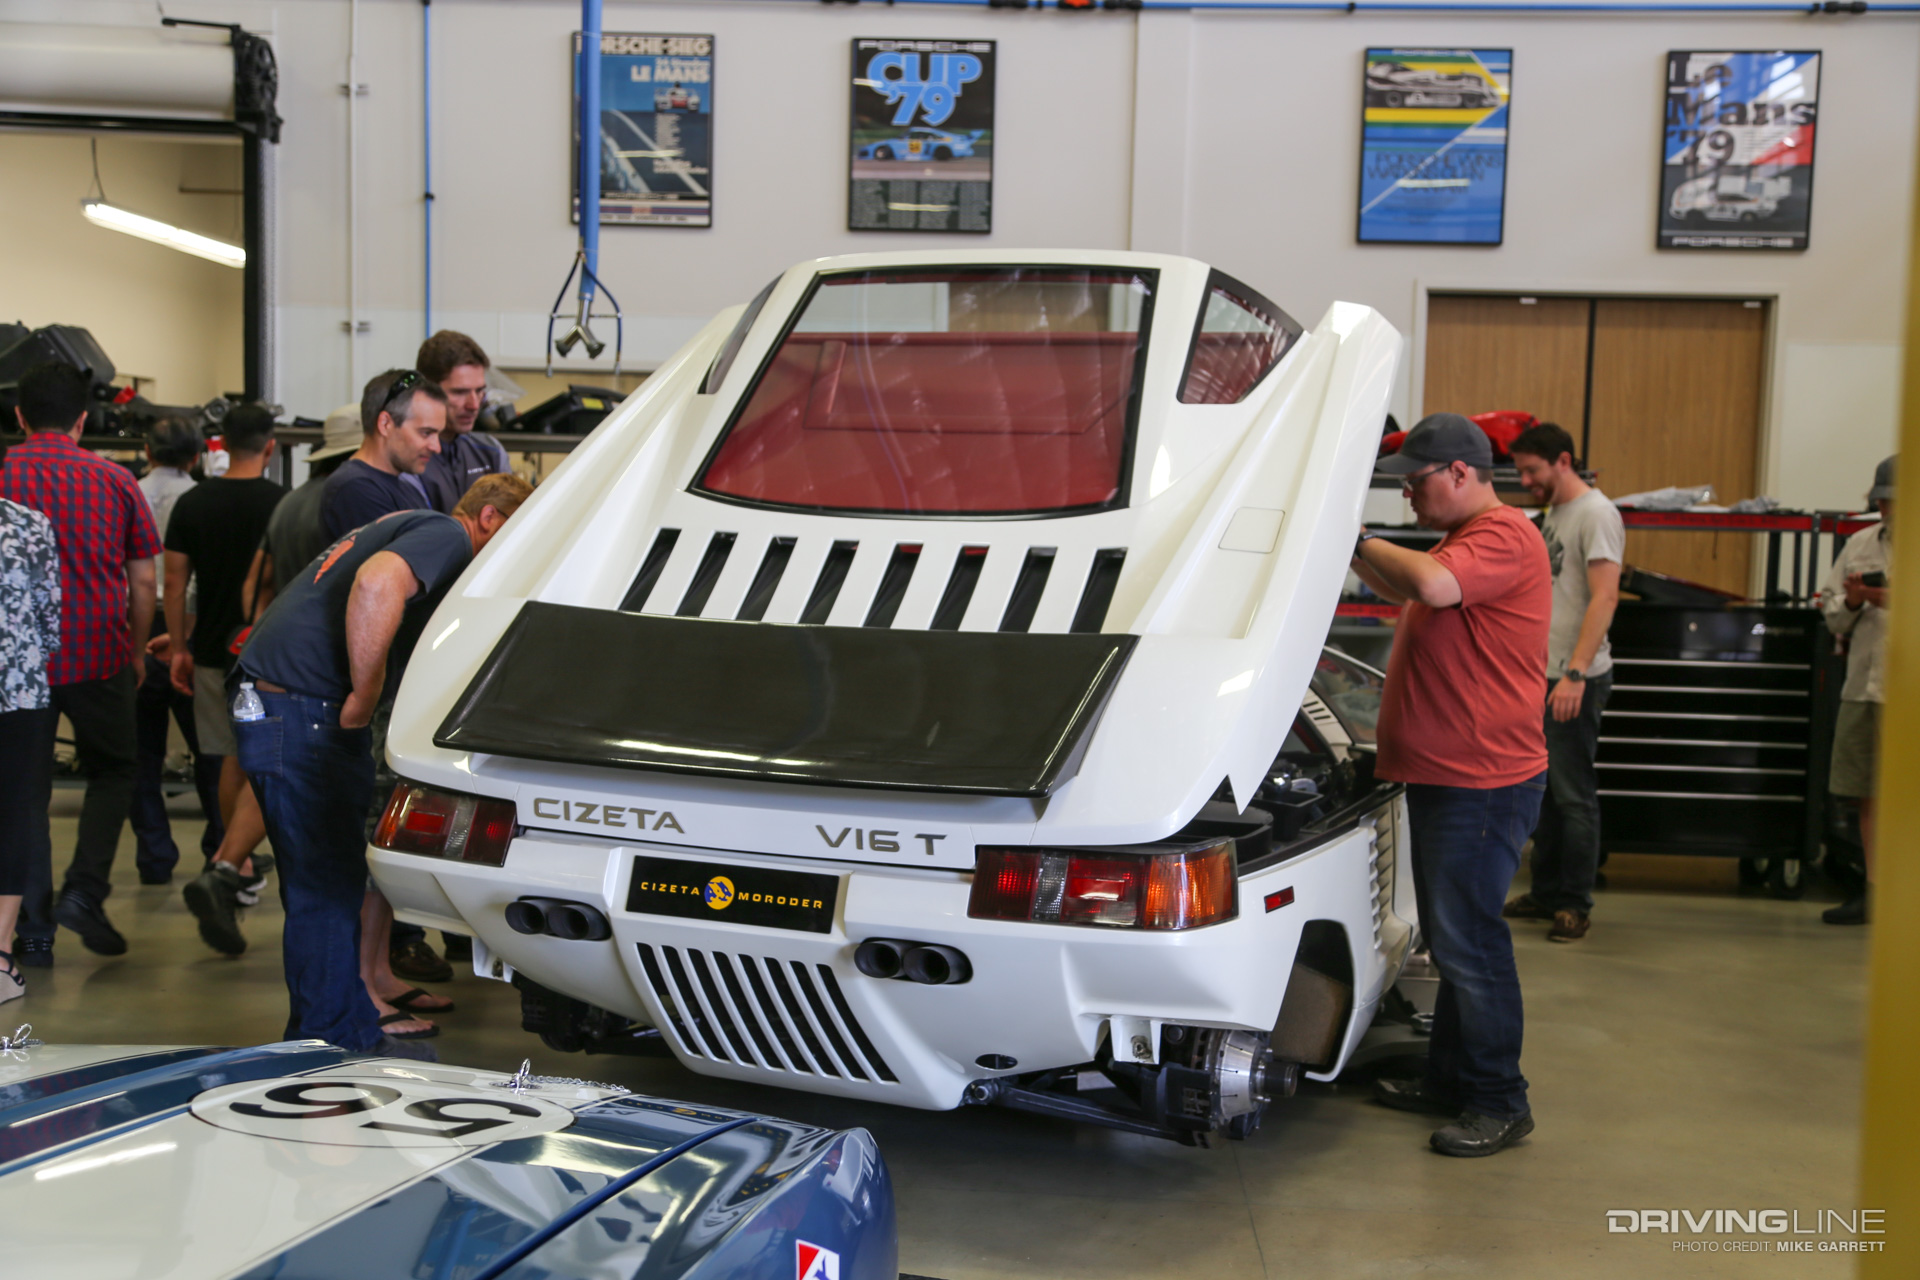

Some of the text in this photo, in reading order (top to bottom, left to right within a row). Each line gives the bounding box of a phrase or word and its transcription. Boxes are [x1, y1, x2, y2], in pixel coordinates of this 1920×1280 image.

[858, 40, 992, 52] PORSCHE
[631, 65, 710, 83] LE MANS
[866, 51, 983, 97] CUP
[885, 82, 956, 126] '79
[1666, 94, 1816, 126] Mans
[533, 797, 685, 834] CIZETA
[914, 833, 948, 856] T
[640, 881, 824, 910] CIZETA MORODER
